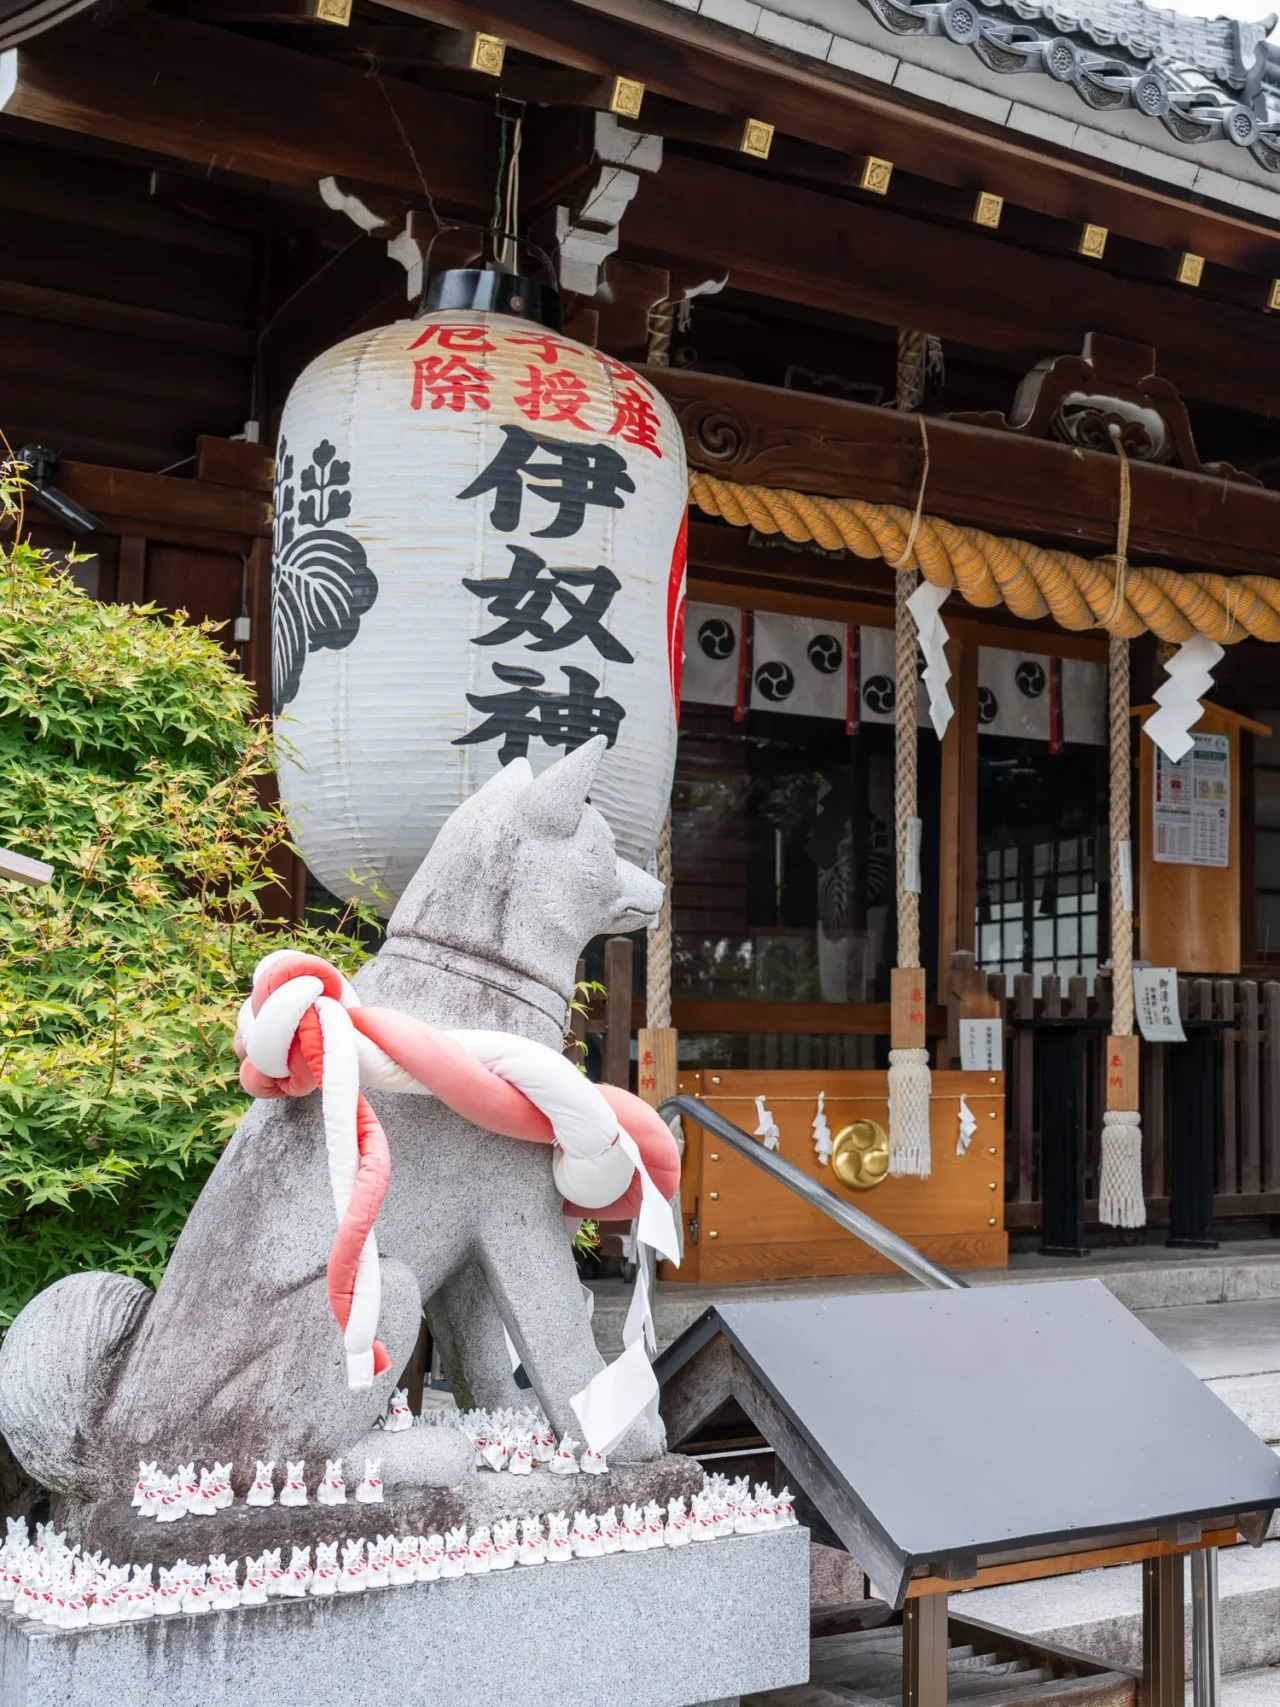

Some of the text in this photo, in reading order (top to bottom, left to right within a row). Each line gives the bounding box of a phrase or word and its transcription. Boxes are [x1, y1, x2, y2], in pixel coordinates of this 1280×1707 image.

[406, 324, 498, 413] 厄除
[503, 328, 596, 432] 子授
[450, 424, 637, 805] 伊奴神
